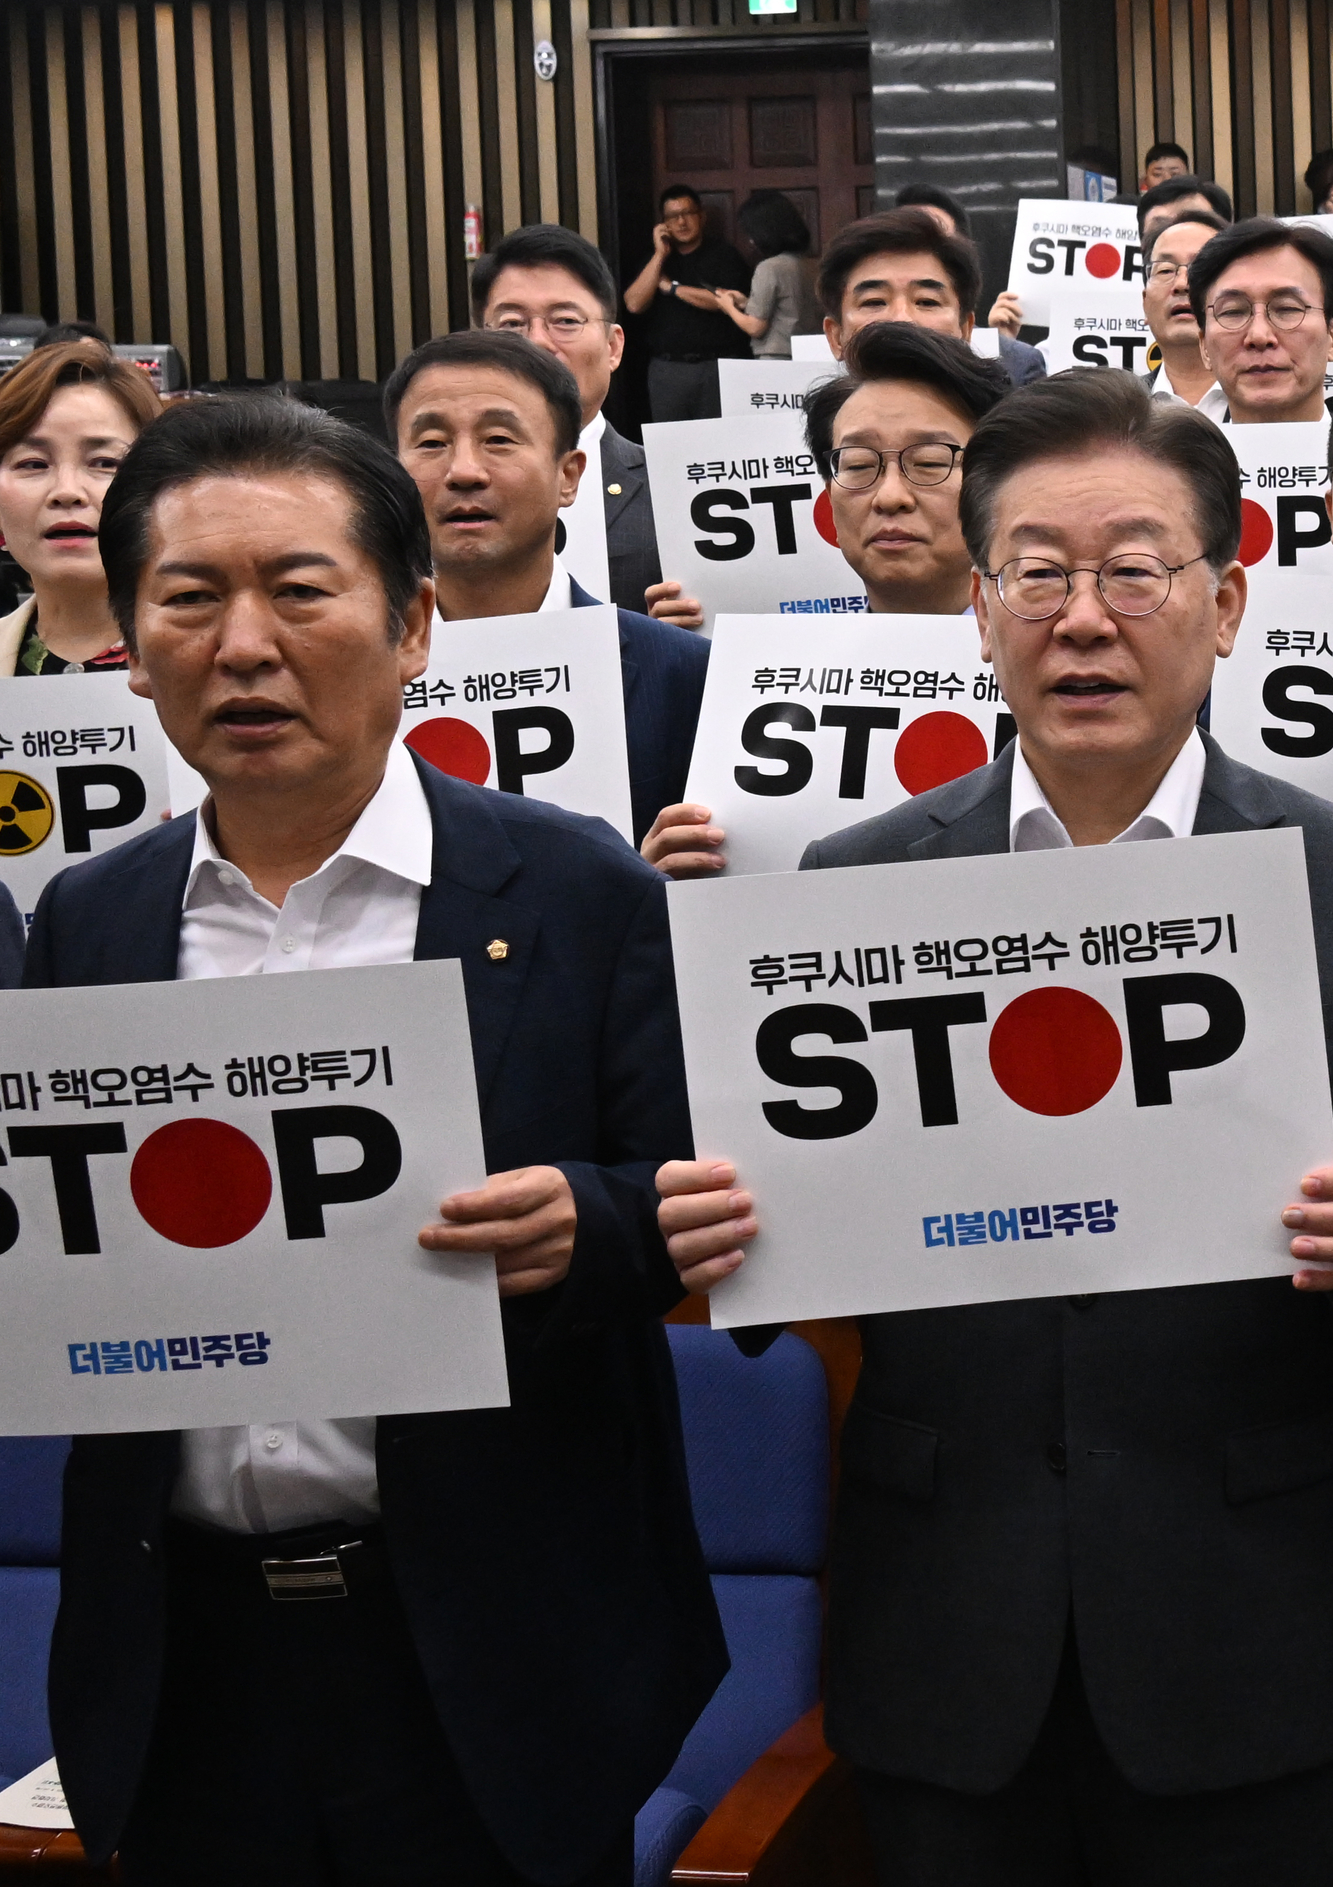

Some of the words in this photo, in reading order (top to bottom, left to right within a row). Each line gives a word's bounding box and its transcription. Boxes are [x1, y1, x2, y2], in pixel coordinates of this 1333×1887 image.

[687, 458, 769, 484] 후쿠시마
[463, 665, 571, 703] 해양투기
[752, 666, 853, 695] 후쿠시마
[860, 668, 965, 700] 핵오염수
[22, 725, 136, 758] 해양투기
[749, 946, 905, 995] 후쿠시마
[912, 931, 1069, 983] 핵오염수
[1079, 914, 1237, 967] 해양투기
[48, 1062, 214, 1109] 핵오염수
[224, 1046, 394, 1099] 해양투기
[922, 1199, 1119, 1248] 더불어민주당
[68, 1331, 270, 1375] 더불어민주당
